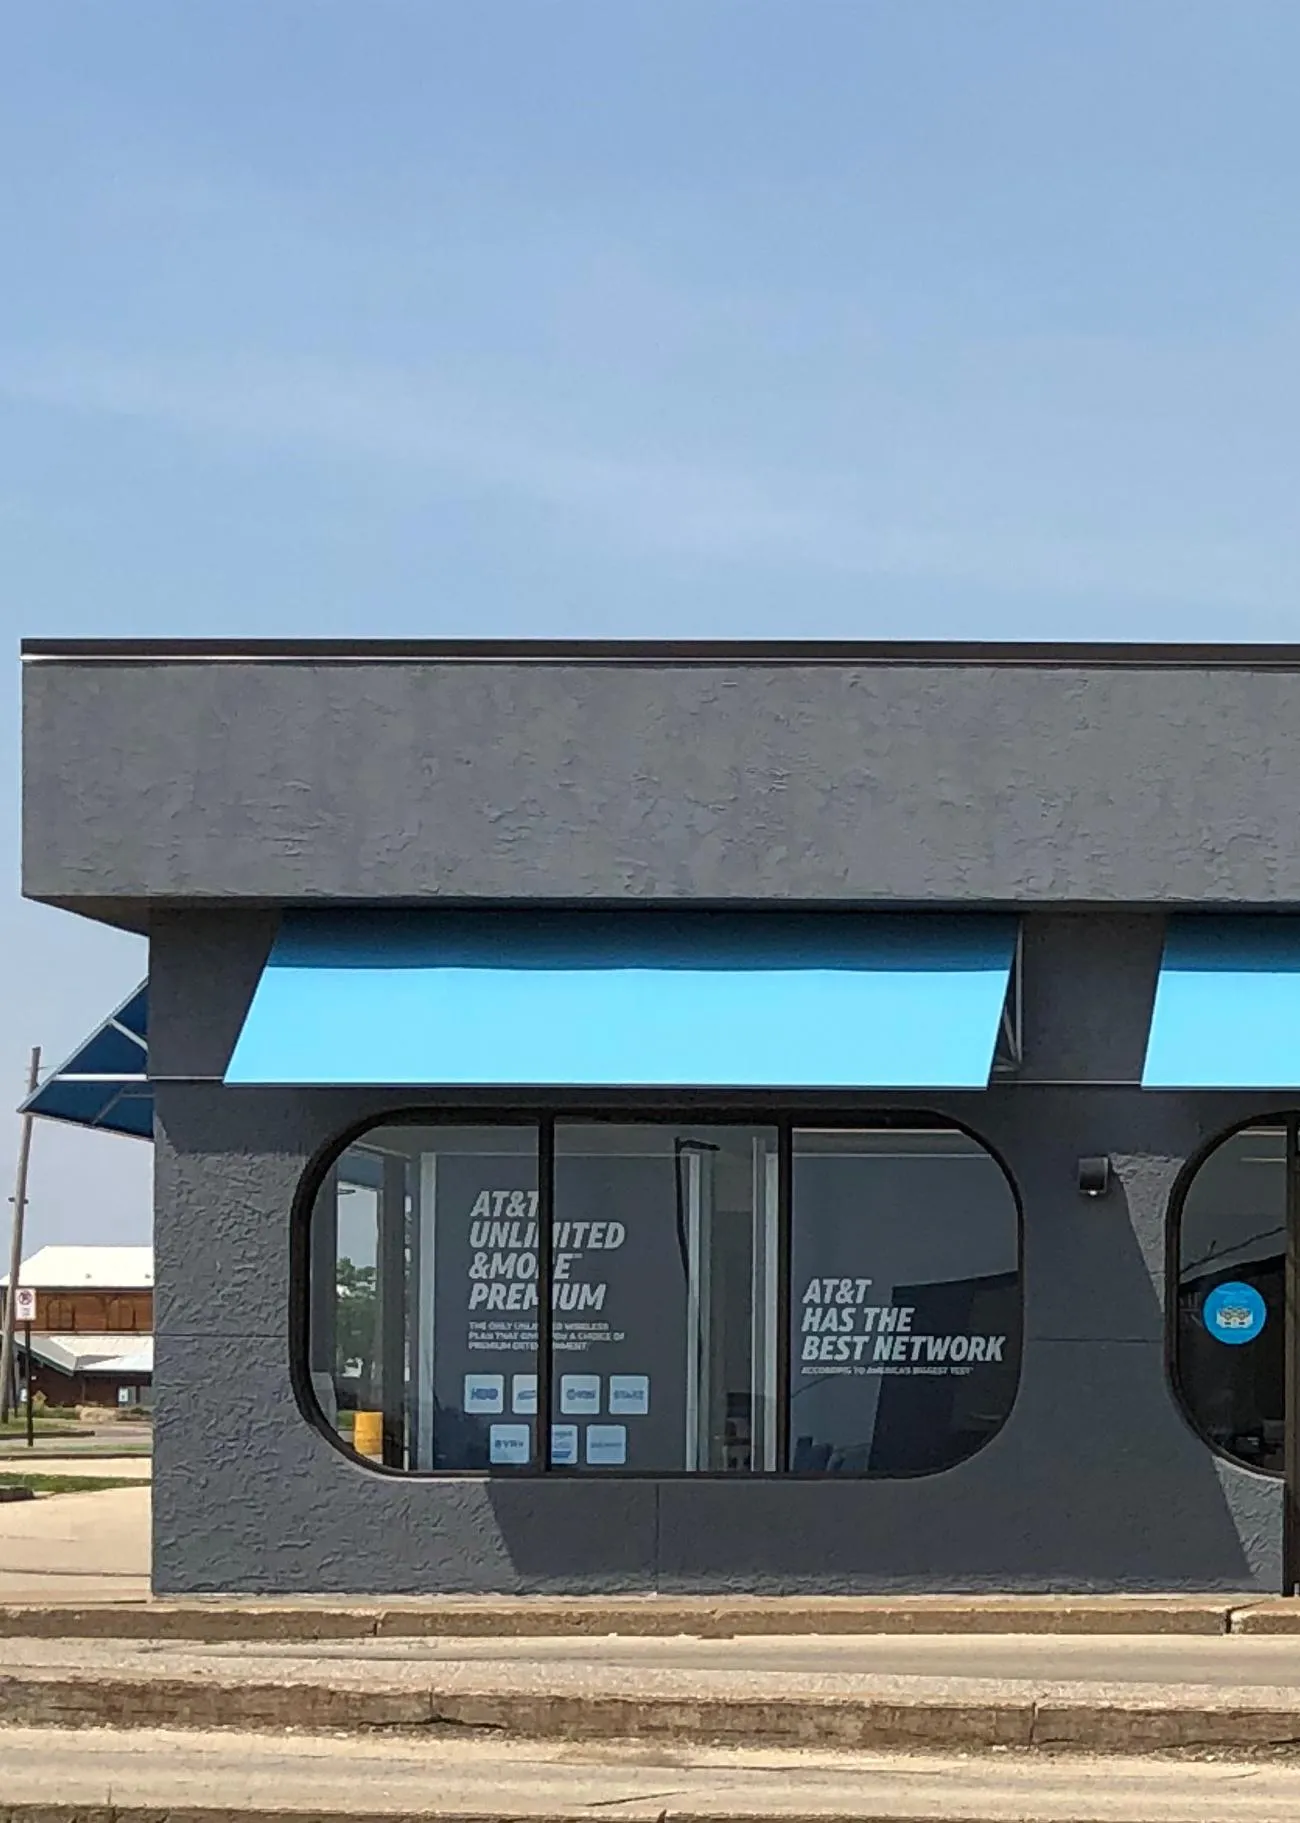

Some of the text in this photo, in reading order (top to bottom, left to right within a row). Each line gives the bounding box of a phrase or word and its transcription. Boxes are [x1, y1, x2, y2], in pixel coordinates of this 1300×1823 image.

[468, 1252, 571, 1280] &MOE
[802, 1278, 872, 1305] AT&T
[801, 1307, 915, 1332] HAS THE
[801, 1336, 1006, 1361] BEST NETWORK
